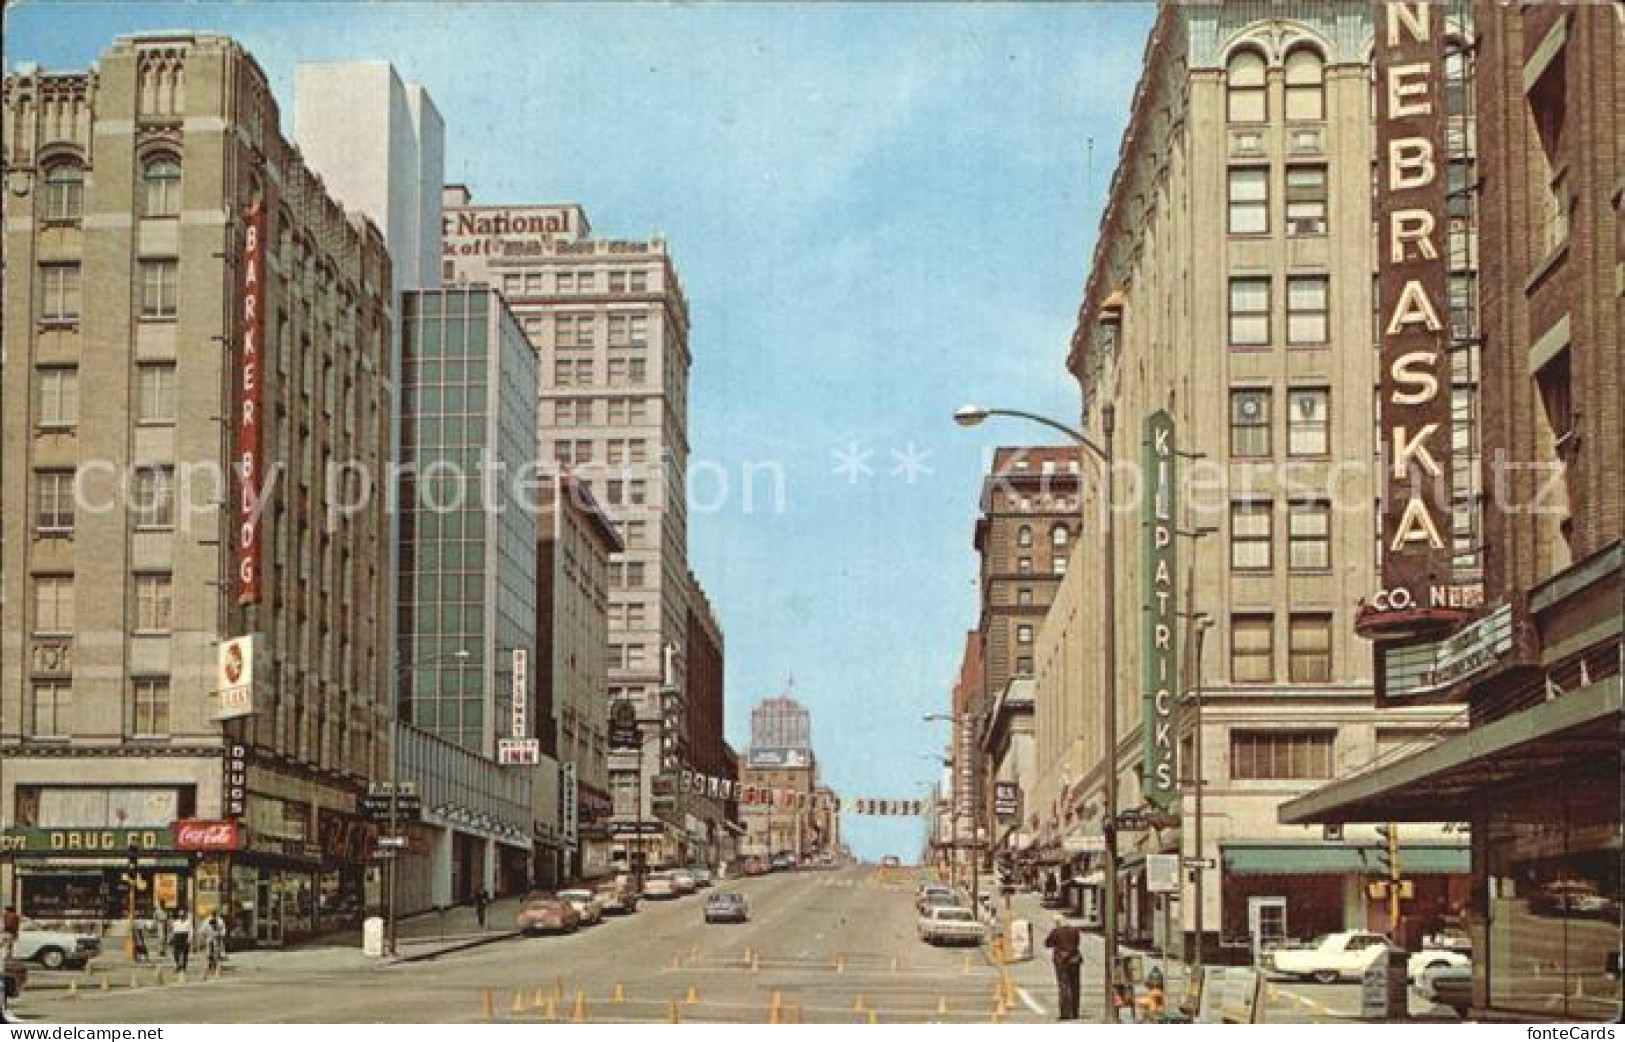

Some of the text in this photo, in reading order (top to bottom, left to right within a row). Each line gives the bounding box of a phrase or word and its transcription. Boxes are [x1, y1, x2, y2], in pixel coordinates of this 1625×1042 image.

[458, 210, 570, 234] National
[1386, 0, 1445, 552] NEBRASKA
[243, 226, 257, 426] BARKER
[1154, 428, 1173, 790] KILPATRICK'S
[1374, 586, 1417, 612] CO.
[231, 744, 245, 814] DRUGS
[51, 832, 114, 848] DRUG
